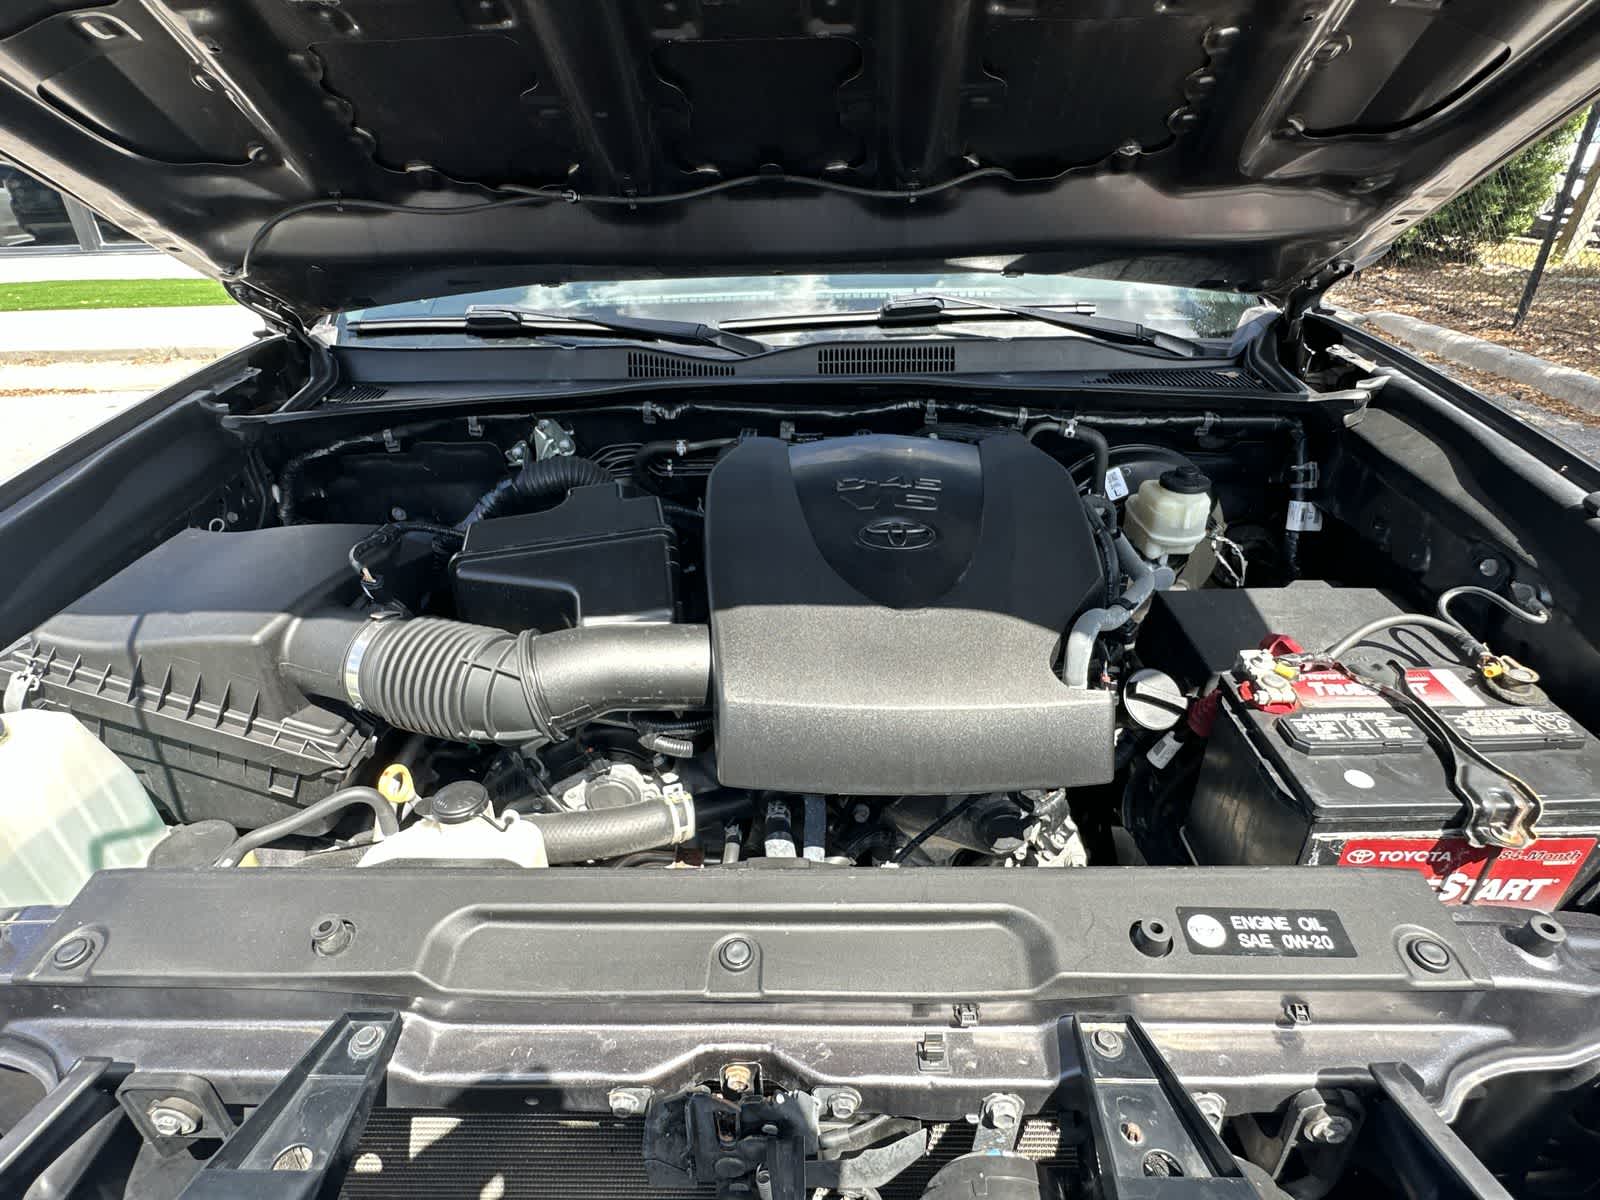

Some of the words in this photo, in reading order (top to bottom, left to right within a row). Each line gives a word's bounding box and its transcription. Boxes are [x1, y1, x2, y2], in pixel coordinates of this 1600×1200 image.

[1379, 851, 1451, 862] TOYOTA
[1230, 915, 1292, 931] ENGINE
[1297, 917, 1328, 932] OIL
[1237, 933, 1274, 948] SAE
[1281, 934, 1335, 950] 0W-20
